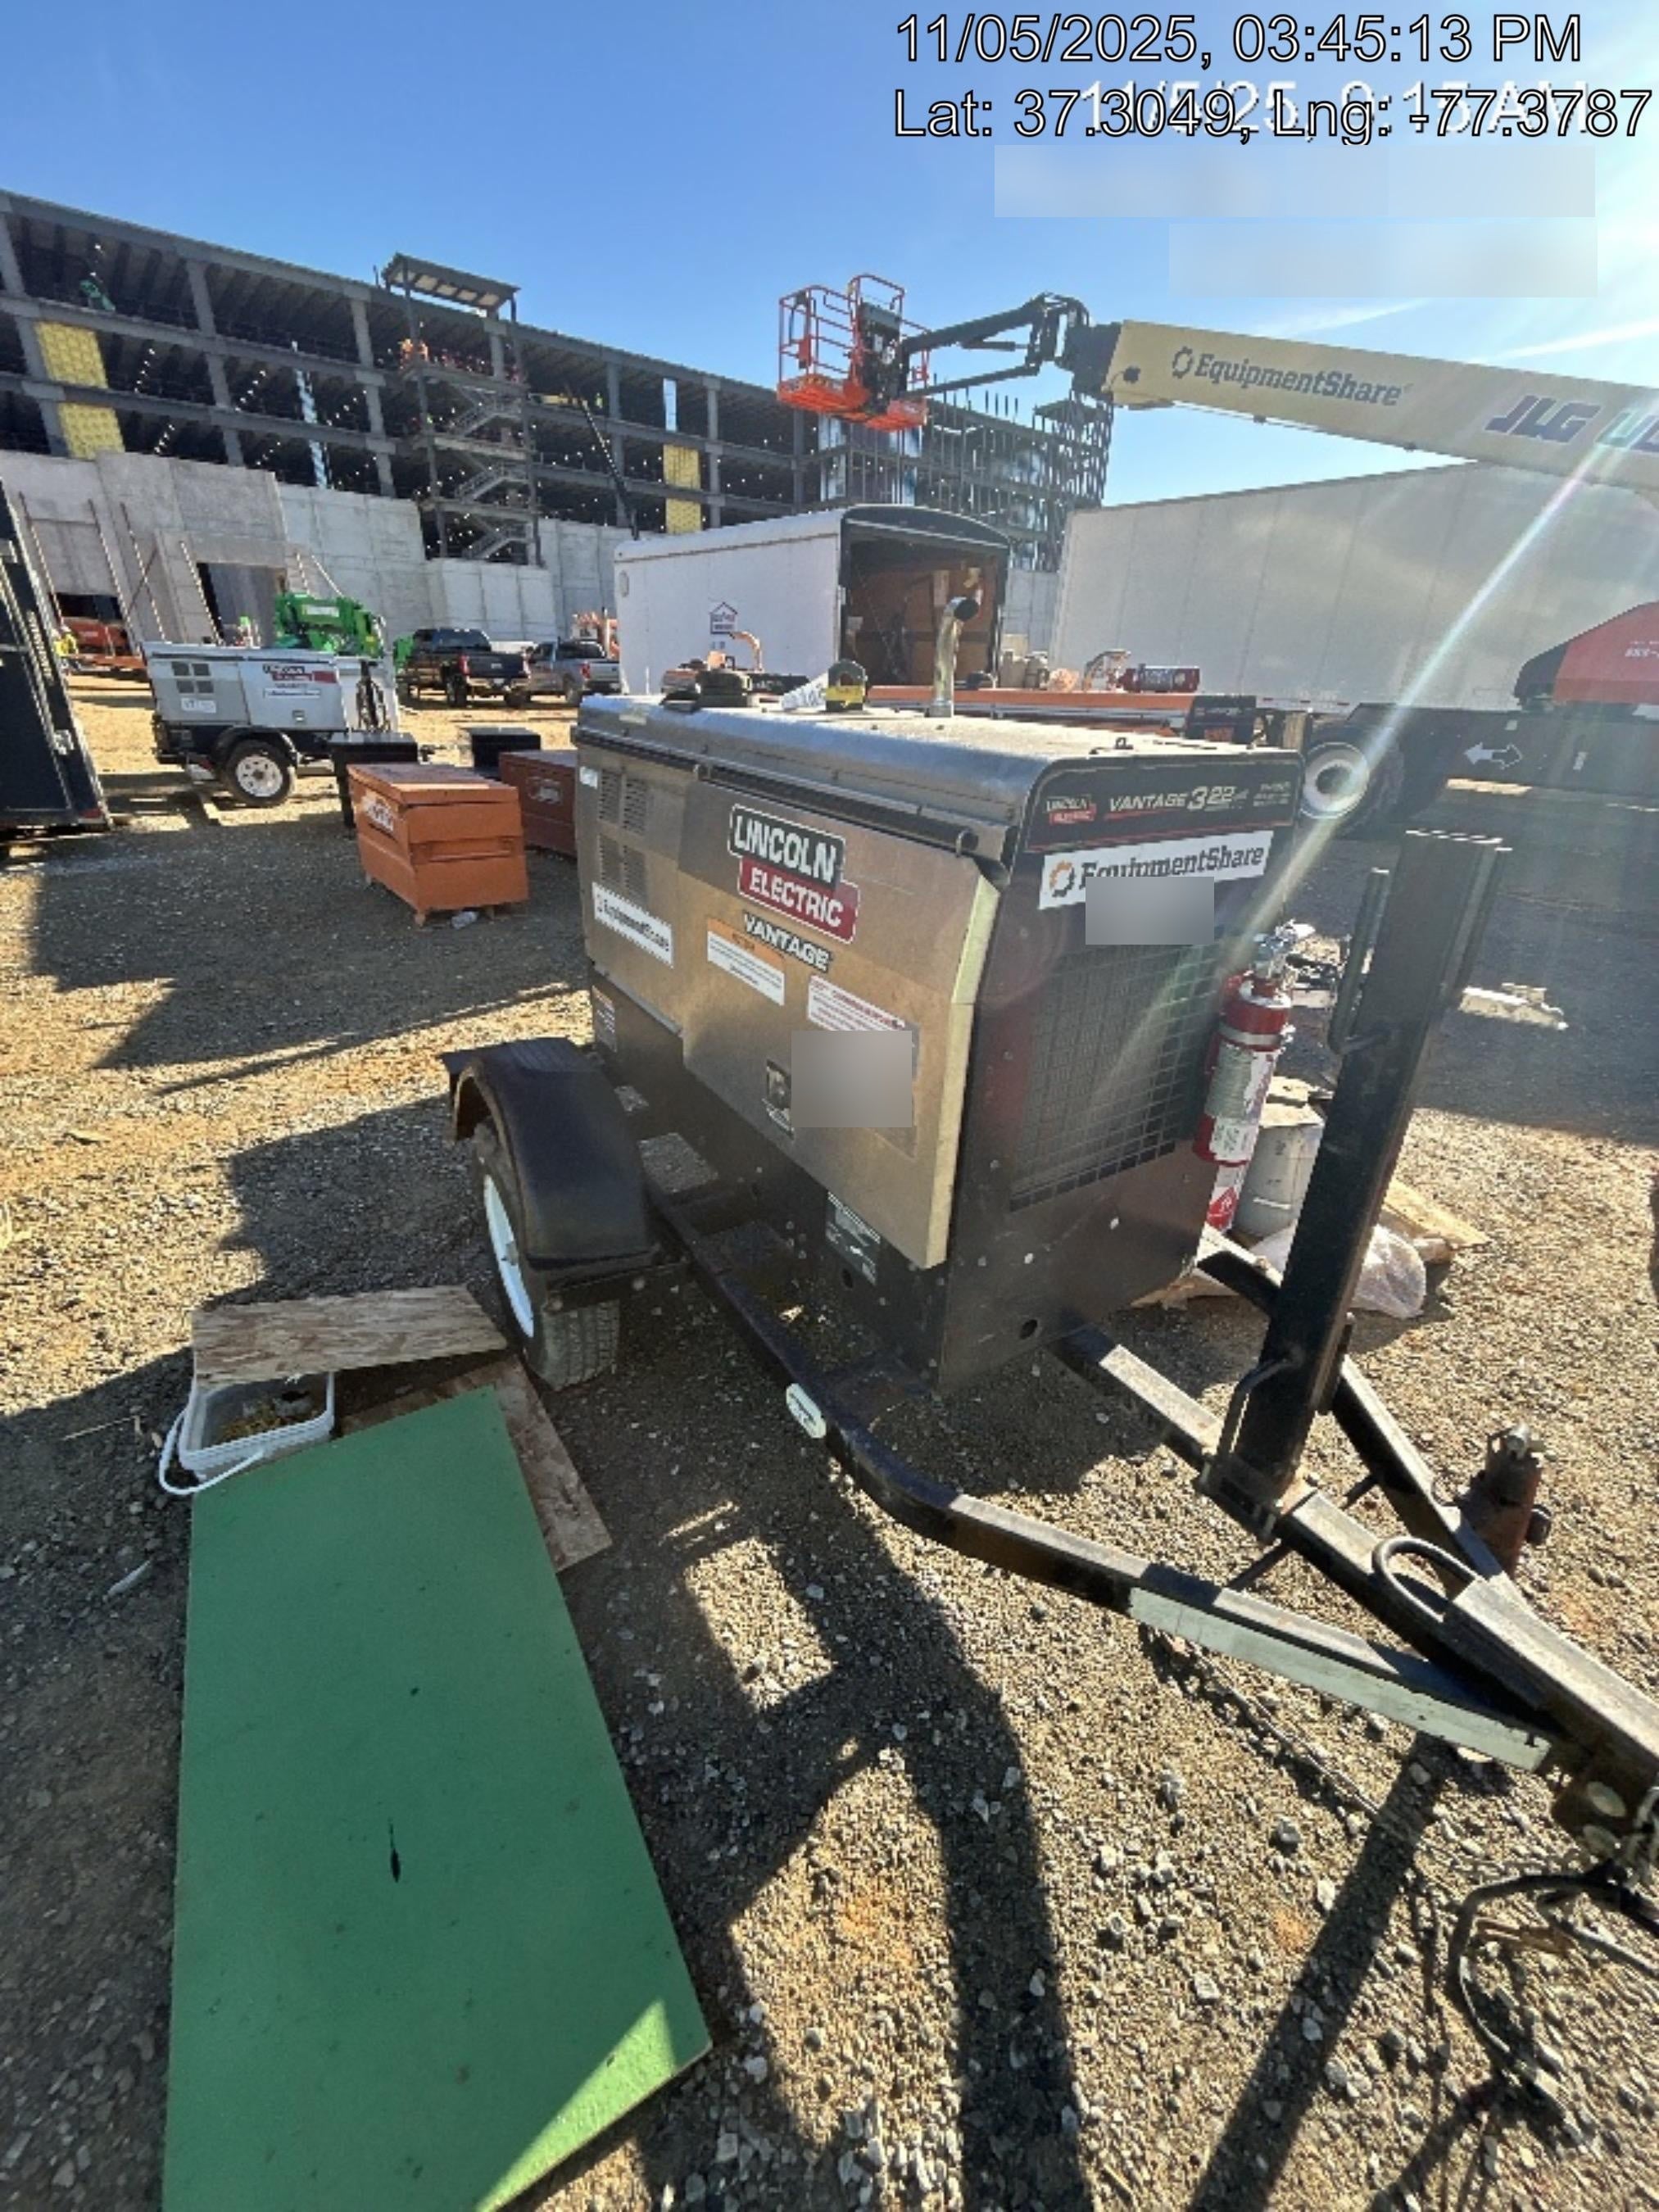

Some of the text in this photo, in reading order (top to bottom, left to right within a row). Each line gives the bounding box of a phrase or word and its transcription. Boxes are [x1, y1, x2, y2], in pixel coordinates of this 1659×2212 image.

[1194, 353, 1403, 406] EquipmentShare
[1483, 394, 1602, 444] JLG
[1109, 793, 1187, 812] VANTAGE
[733, 815, 836, 883] LINCOLN
[749, 867, 844, 927] ELECTRIC
[744, 912, 832, 973] VANTAGE
